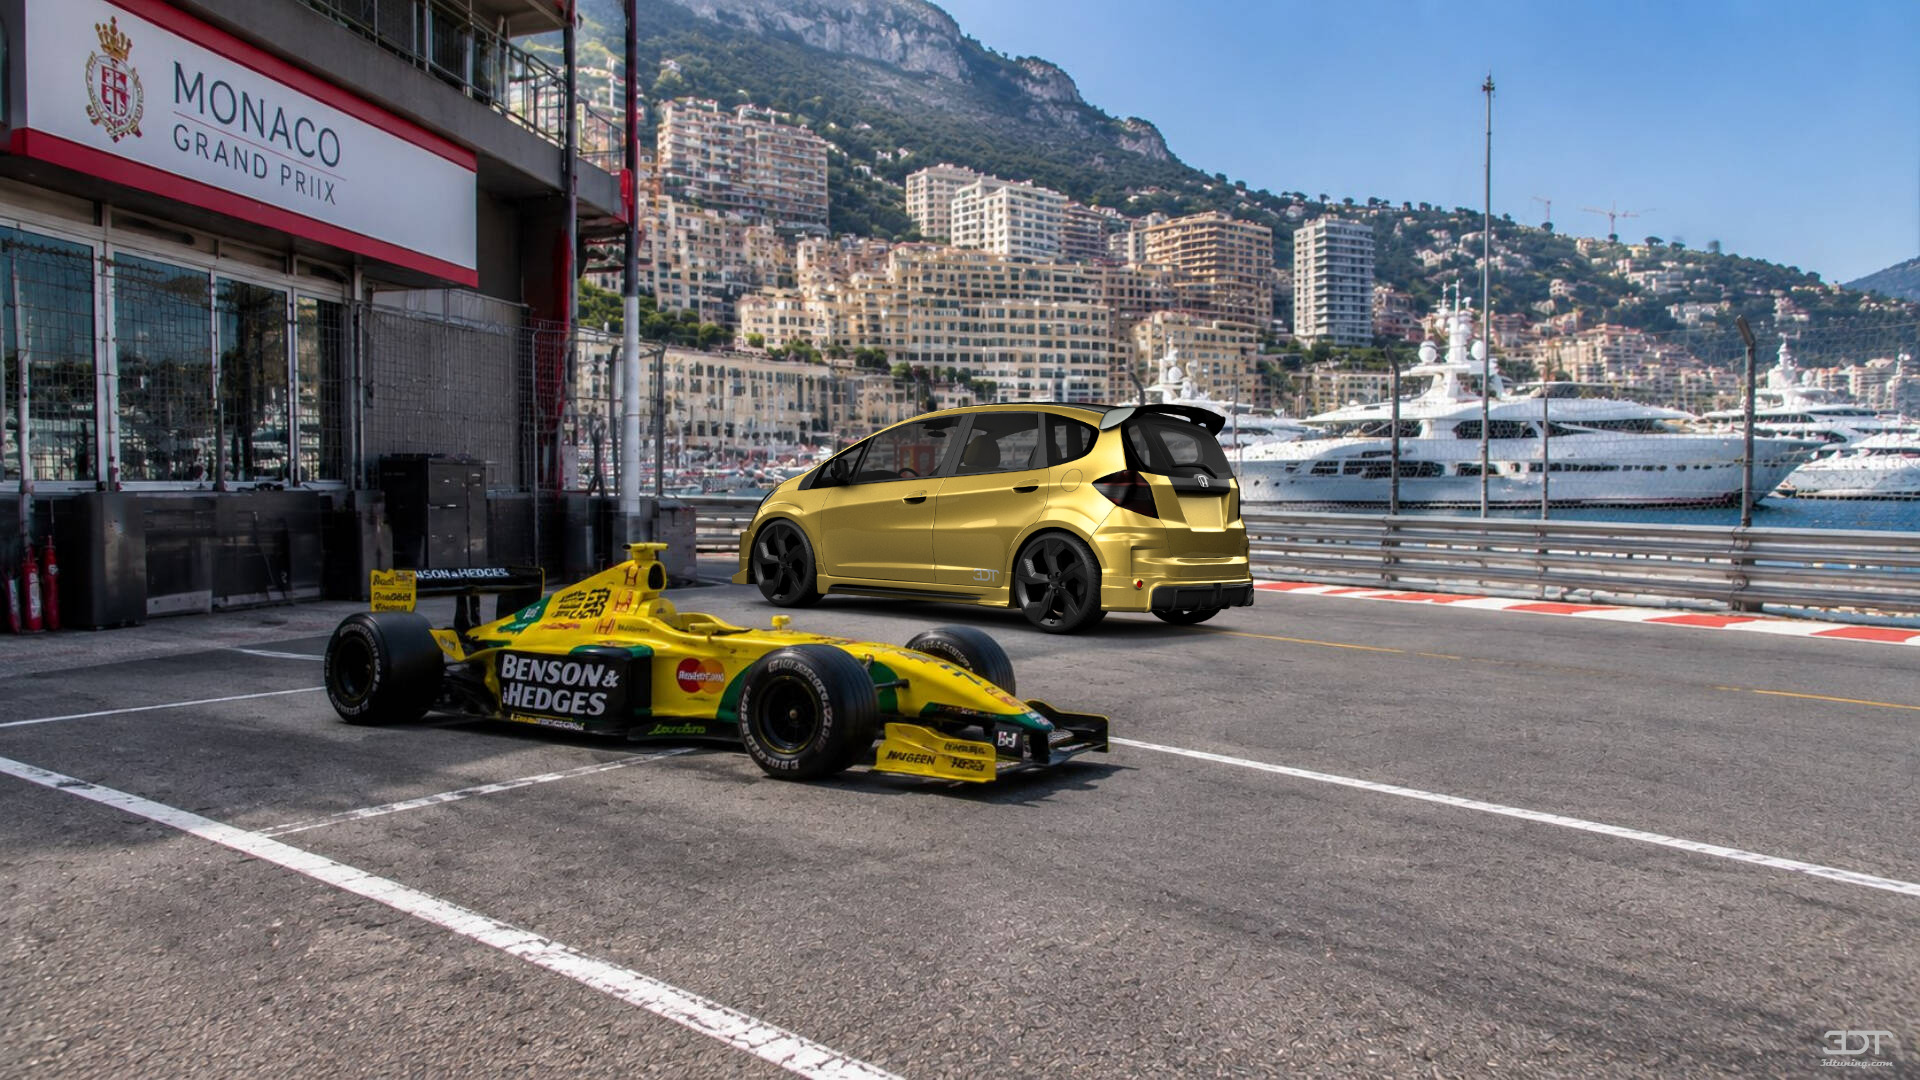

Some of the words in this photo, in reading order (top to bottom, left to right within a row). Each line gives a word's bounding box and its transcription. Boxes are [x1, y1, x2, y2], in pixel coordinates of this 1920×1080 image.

[174, 60, 341, 168] MONACO
[173, 123, 268, 179] GRAND
[281, 163, 336, 206] PRIIX
[507, 681, 608, 716] HEDGES
